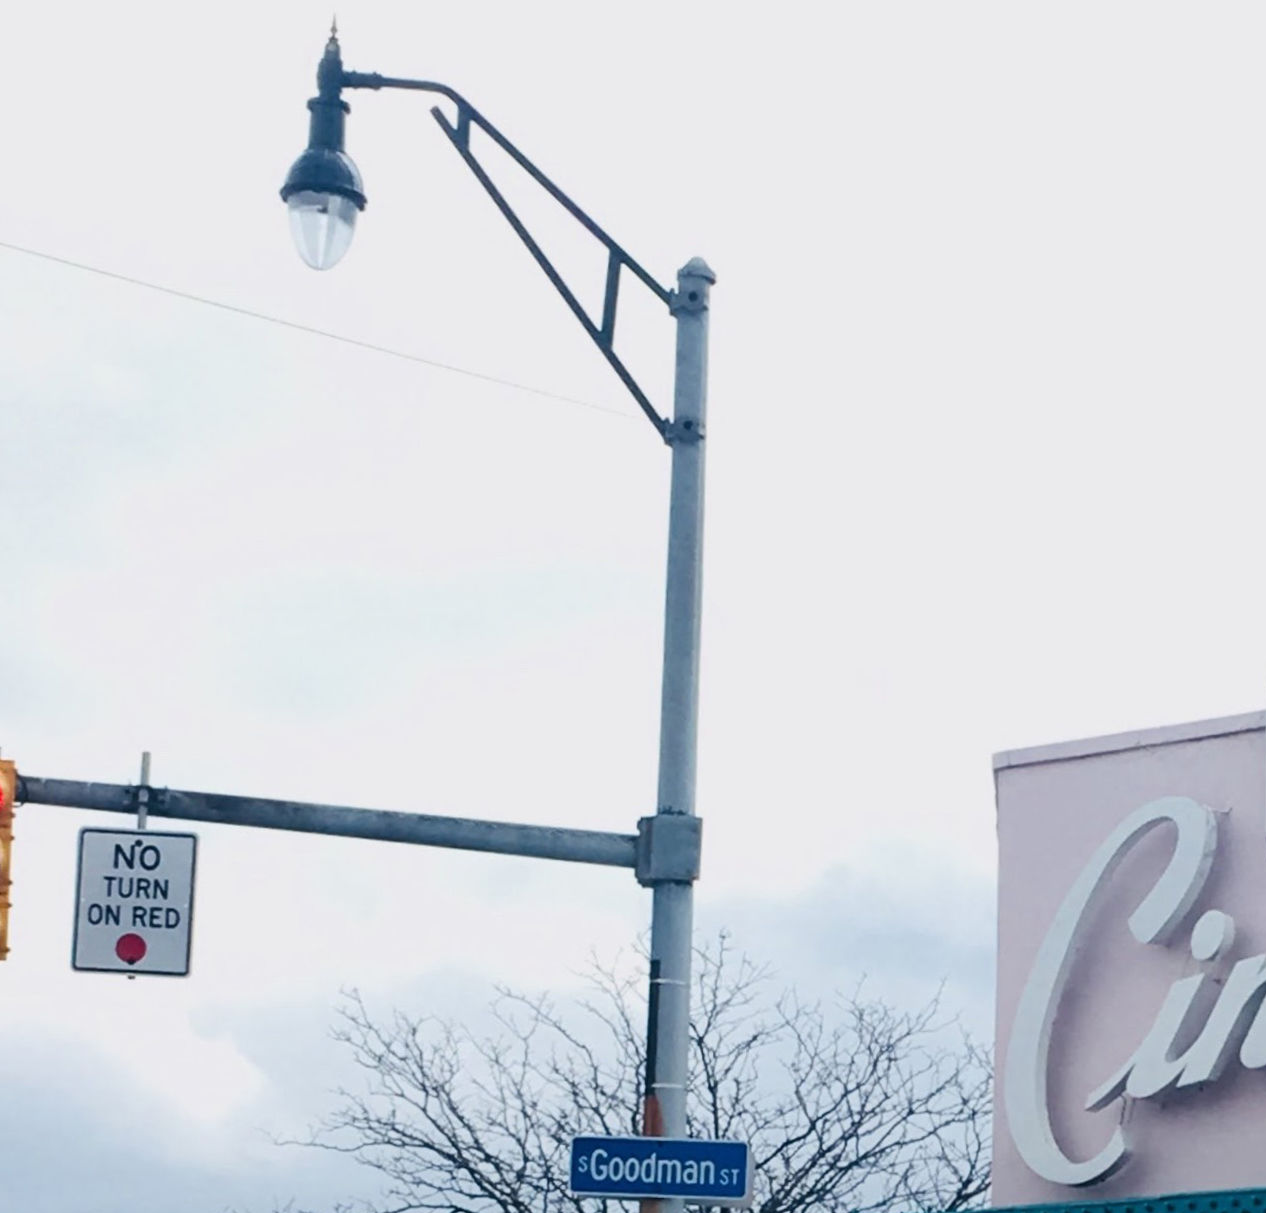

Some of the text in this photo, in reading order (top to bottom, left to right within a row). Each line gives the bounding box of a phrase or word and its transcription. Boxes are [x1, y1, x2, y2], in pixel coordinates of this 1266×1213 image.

[113, 843, 161, 871] NO
[103, 876, 169, 900] TURN
[87, 903, 181, 929] ON RED
[578, 1149, 740, 1186] S Goodman ST
